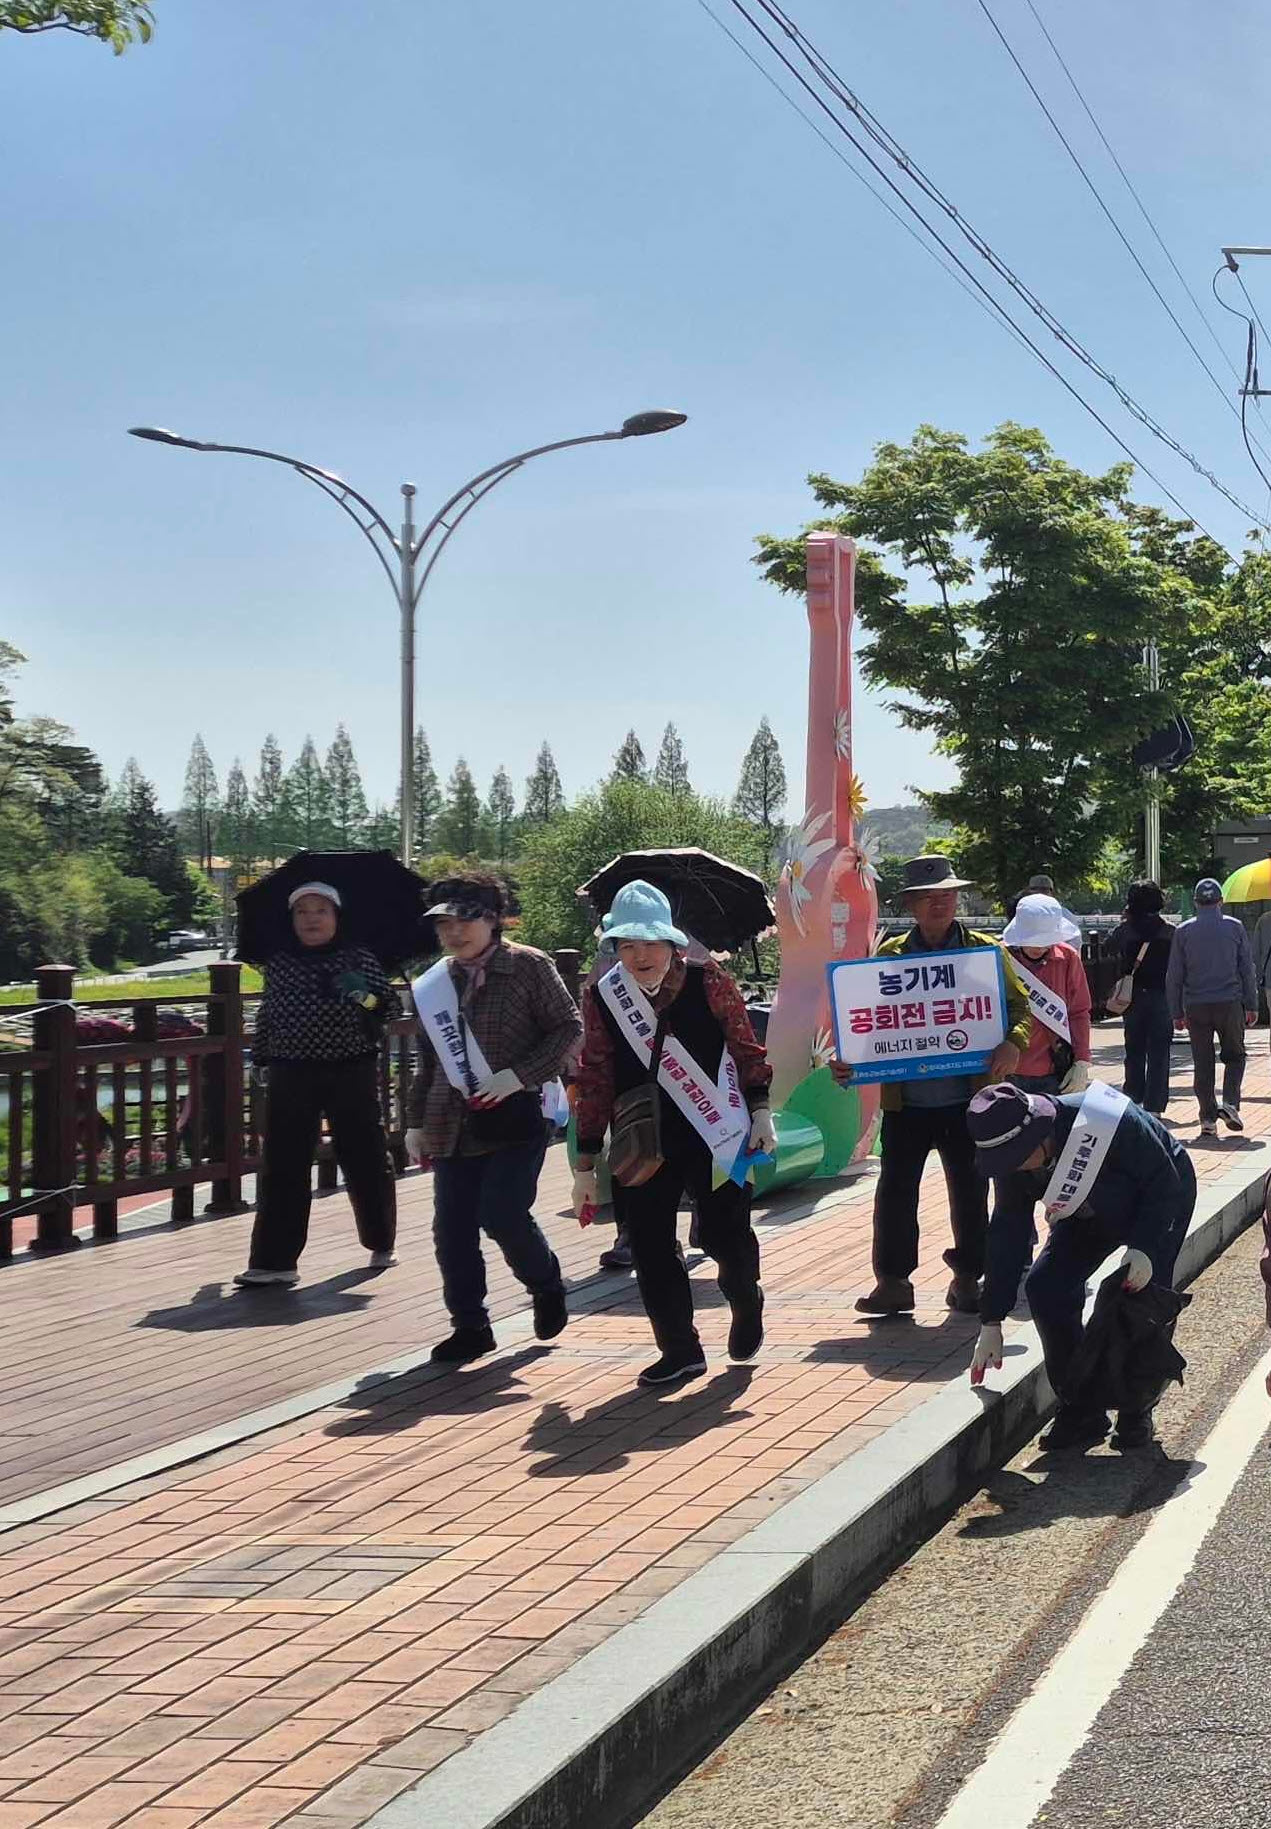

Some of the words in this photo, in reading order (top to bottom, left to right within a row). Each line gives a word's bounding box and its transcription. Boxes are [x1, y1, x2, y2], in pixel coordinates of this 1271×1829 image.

[878, 963, 956, 996] 농기계
[627, 1011, 652, 1038] 대응
[848, 1004, 927, 1034] 공회전
[932, 996, 992, 1025] 금지!
[874, 1039, 912, 1055] 에너지
[914, 1036, 940, 1051] 절약
[1065, 1133, 1097, 1182] 기후변화
